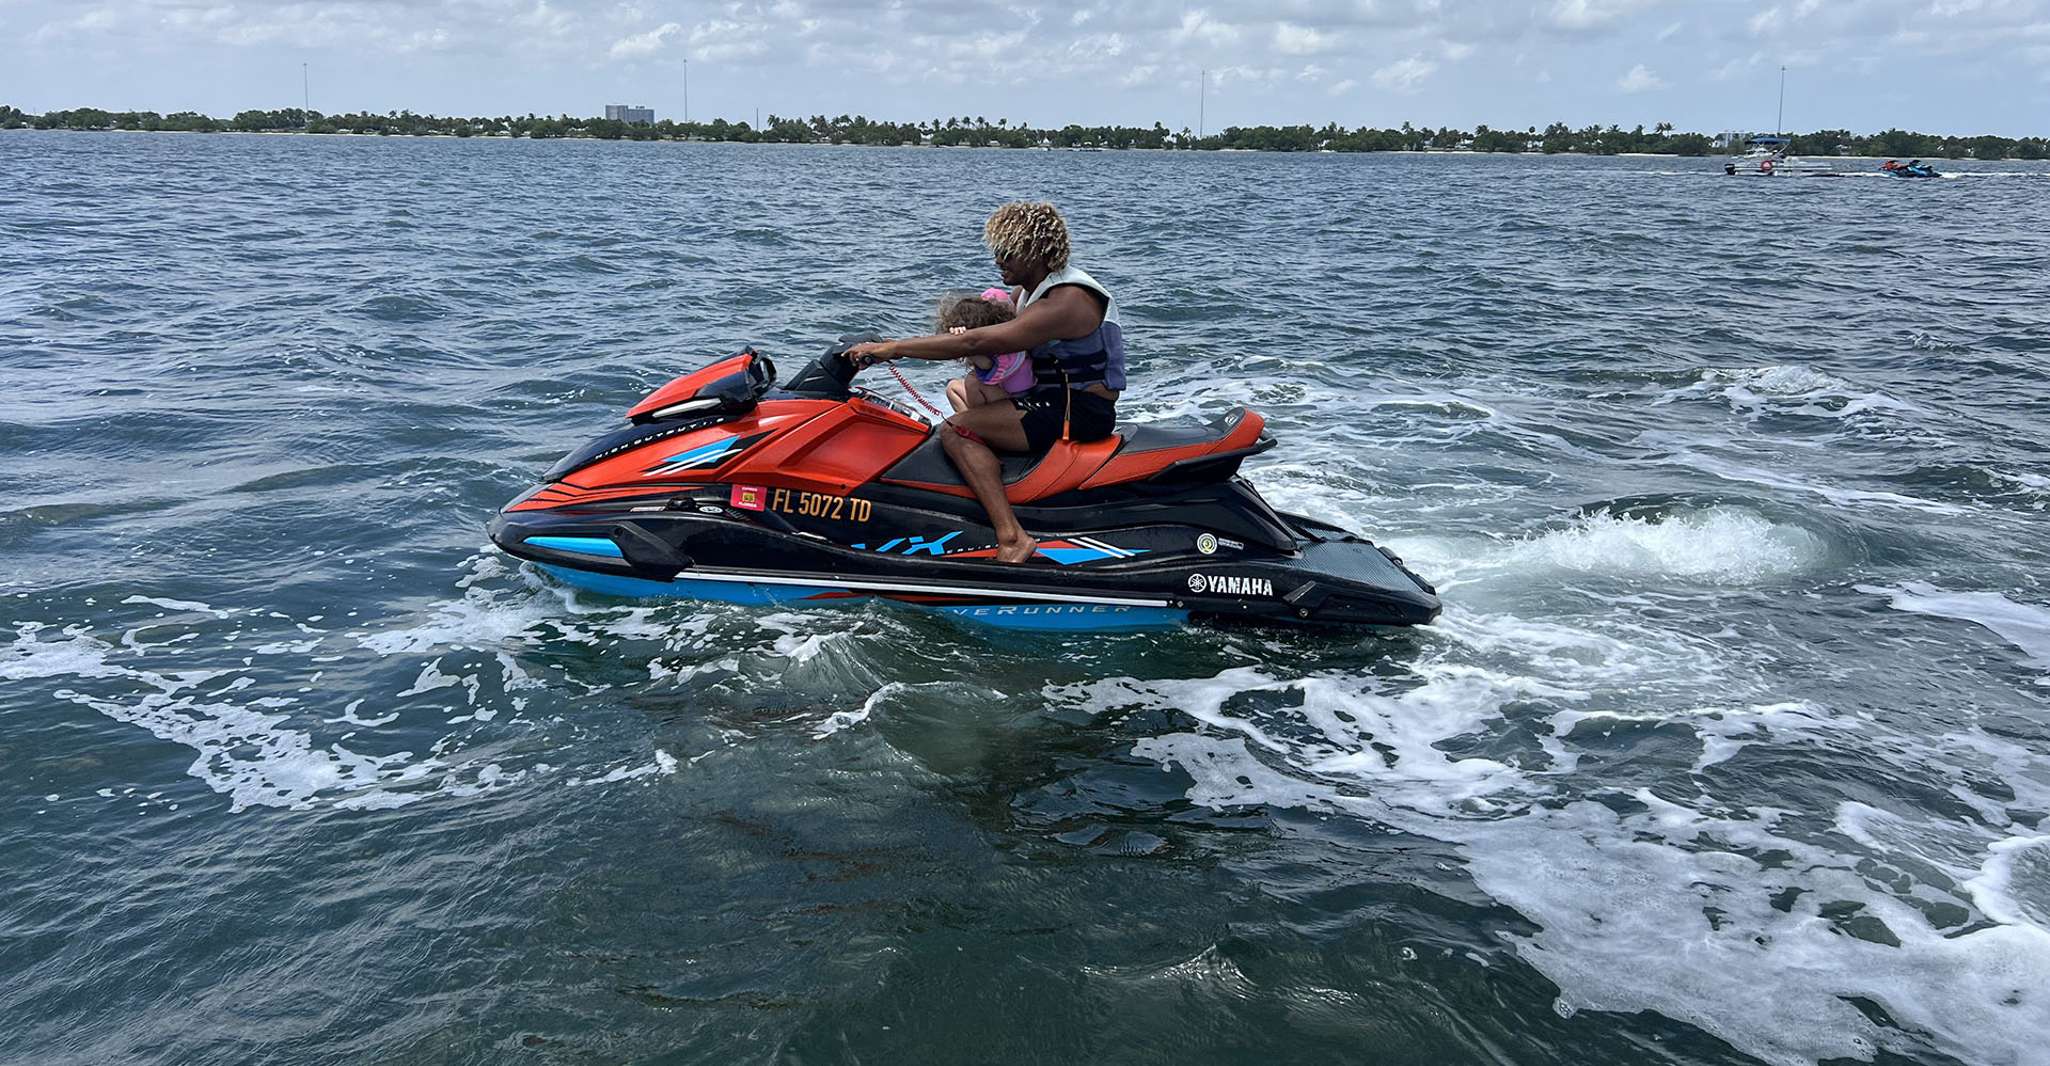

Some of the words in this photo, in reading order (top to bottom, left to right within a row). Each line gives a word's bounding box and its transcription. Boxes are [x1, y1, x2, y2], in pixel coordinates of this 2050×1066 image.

[771, 488, 794, 514] FL
[798, 491, 843, 520] 5072
[849, 497, 872, 522] TD
[1207, 576, 1274, 597] YAMAHA
[952, 605, 1131, 616] VERUNNER
